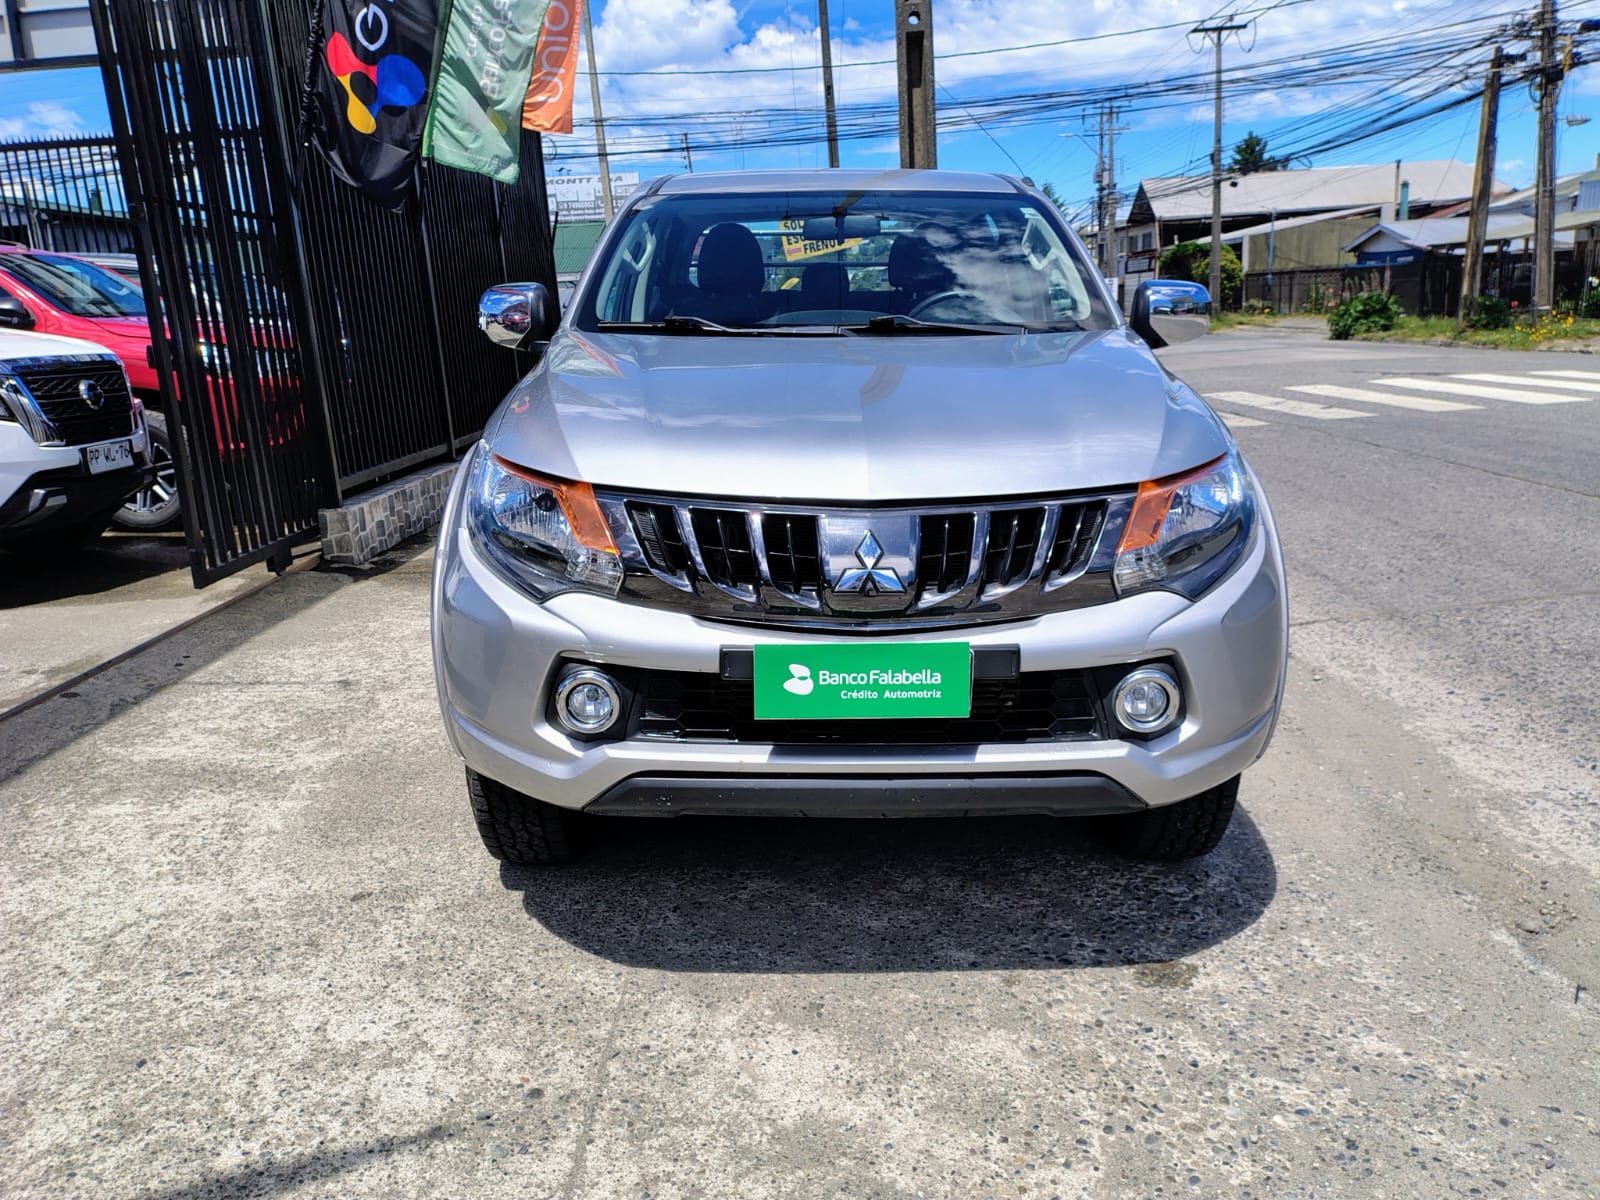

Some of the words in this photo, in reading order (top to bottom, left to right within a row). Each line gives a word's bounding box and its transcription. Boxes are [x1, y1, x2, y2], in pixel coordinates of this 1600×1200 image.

[354, 3, 389, 50] G
[818, 670, 868, 685] Banco
[869, 669, 942, 685] Falabella
[840, 689, 878, 699] Crédito
[883, 689, 942, 699] Automotriz
